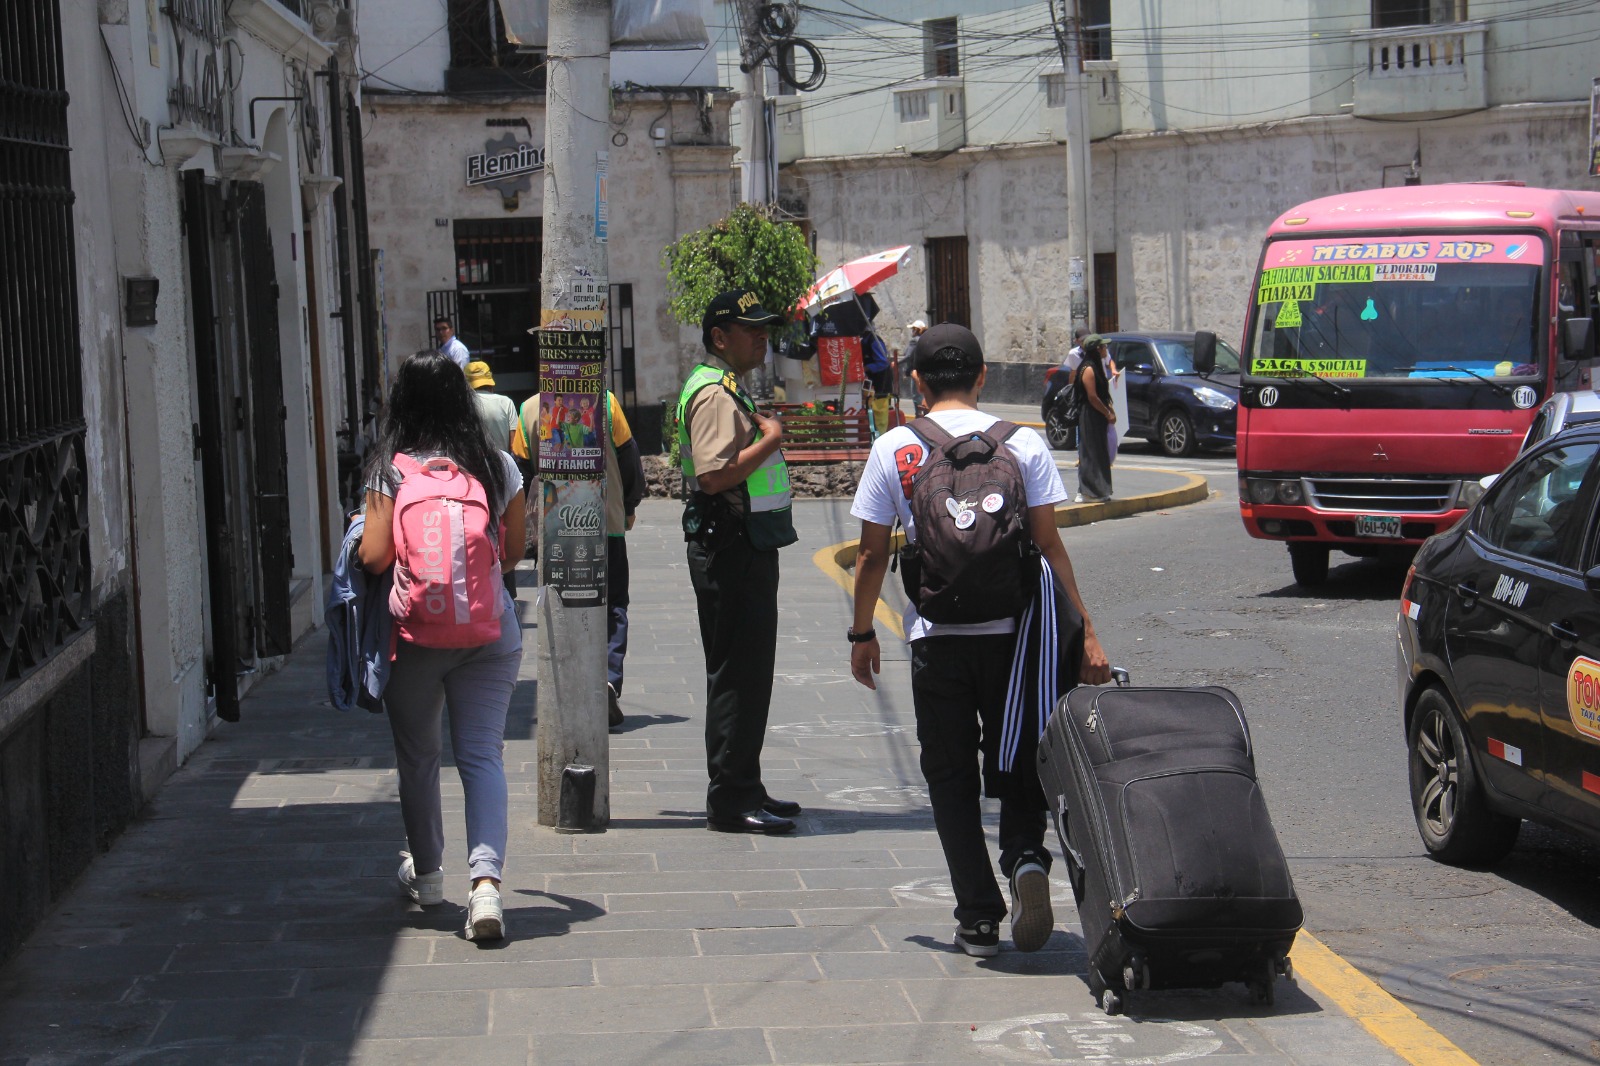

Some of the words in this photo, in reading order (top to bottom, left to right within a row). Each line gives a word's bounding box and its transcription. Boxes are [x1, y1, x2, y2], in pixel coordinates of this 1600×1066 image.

[1313, 244, 1430, 260] MEGABUS
[1435, 241, 1494, 260] AQP
[1317, 265, 1371, 281] SACHACA
[1376, 265, 1389, 274] EL
[1390, 265, 1435, 274] DORADO
[1260, 284, 1312, 303] TIABAYA
[1317, 360, 1363, 371] SOCIAL
[555, 376, 601, 393] LÍDERES
[1262, 388, 1277, 405] 60
[1514, 386, 1535, 404] C-10
[558, 459, 596, 470] FRANCK
[559, 504, 600, 530] Vida
[1357, 521, 1399, 534] V6U-947
[417, 511, 447, 614] adidas
[1581, 708, 1595, 721] TAXI
